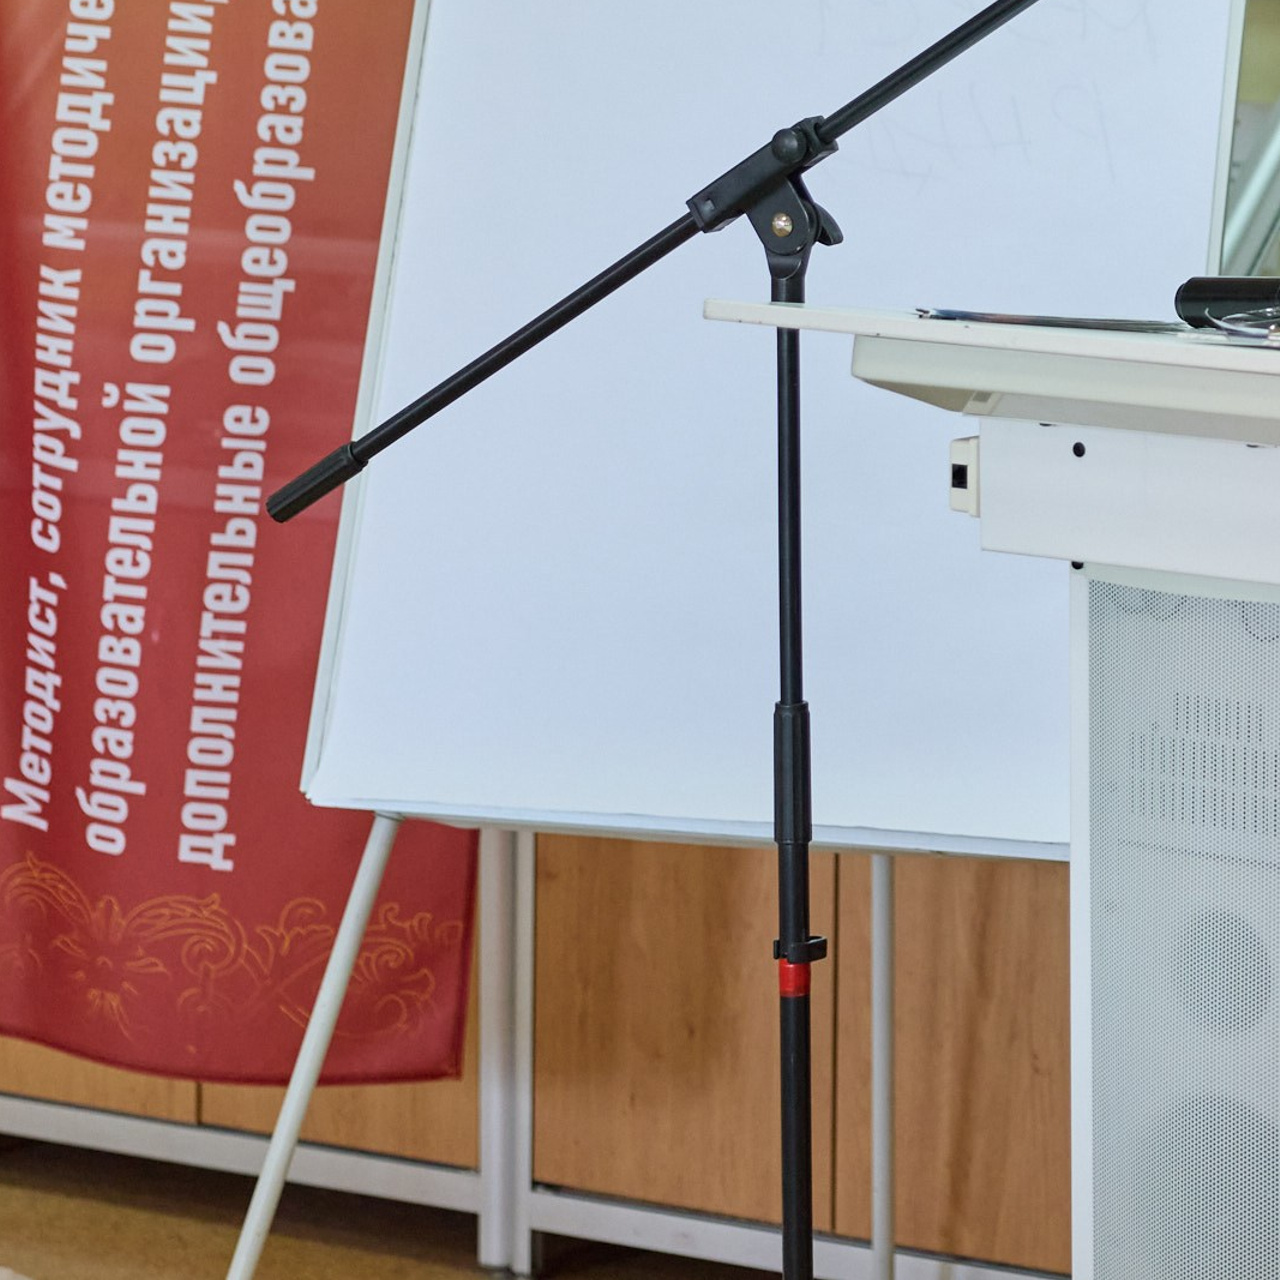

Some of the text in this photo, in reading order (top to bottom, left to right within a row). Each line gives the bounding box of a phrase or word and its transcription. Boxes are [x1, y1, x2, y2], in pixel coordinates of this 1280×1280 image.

[30, 264, 83, 553] сотрудник
[0, 572, 67, 832] Методист,
[75, 381, 172, 856] образовательной
[177, 404, 271, 872] дополнительные
